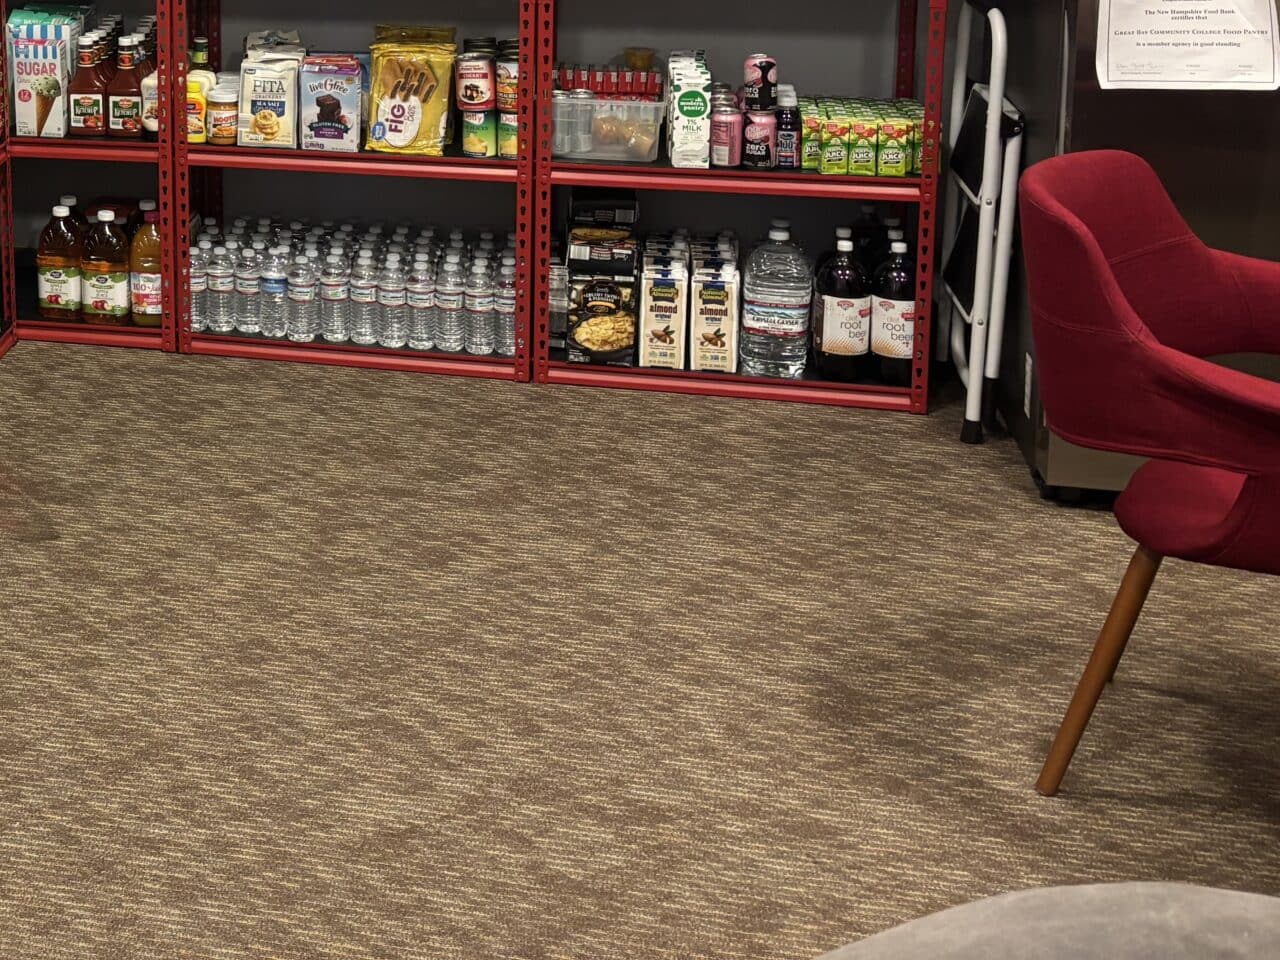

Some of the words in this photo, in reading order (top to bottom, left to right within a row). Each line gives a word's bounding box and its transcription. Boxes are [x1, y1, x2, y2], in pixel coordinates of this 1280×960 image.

[16, 62, 57, 76] SUGAR
[252, 79, 286, 92] PITA
[650, 304, 678, 314] almond
[698, 306, 728, 316] almond
[840, 320, 862, 330] root
[882, 322, 906, 332] root
